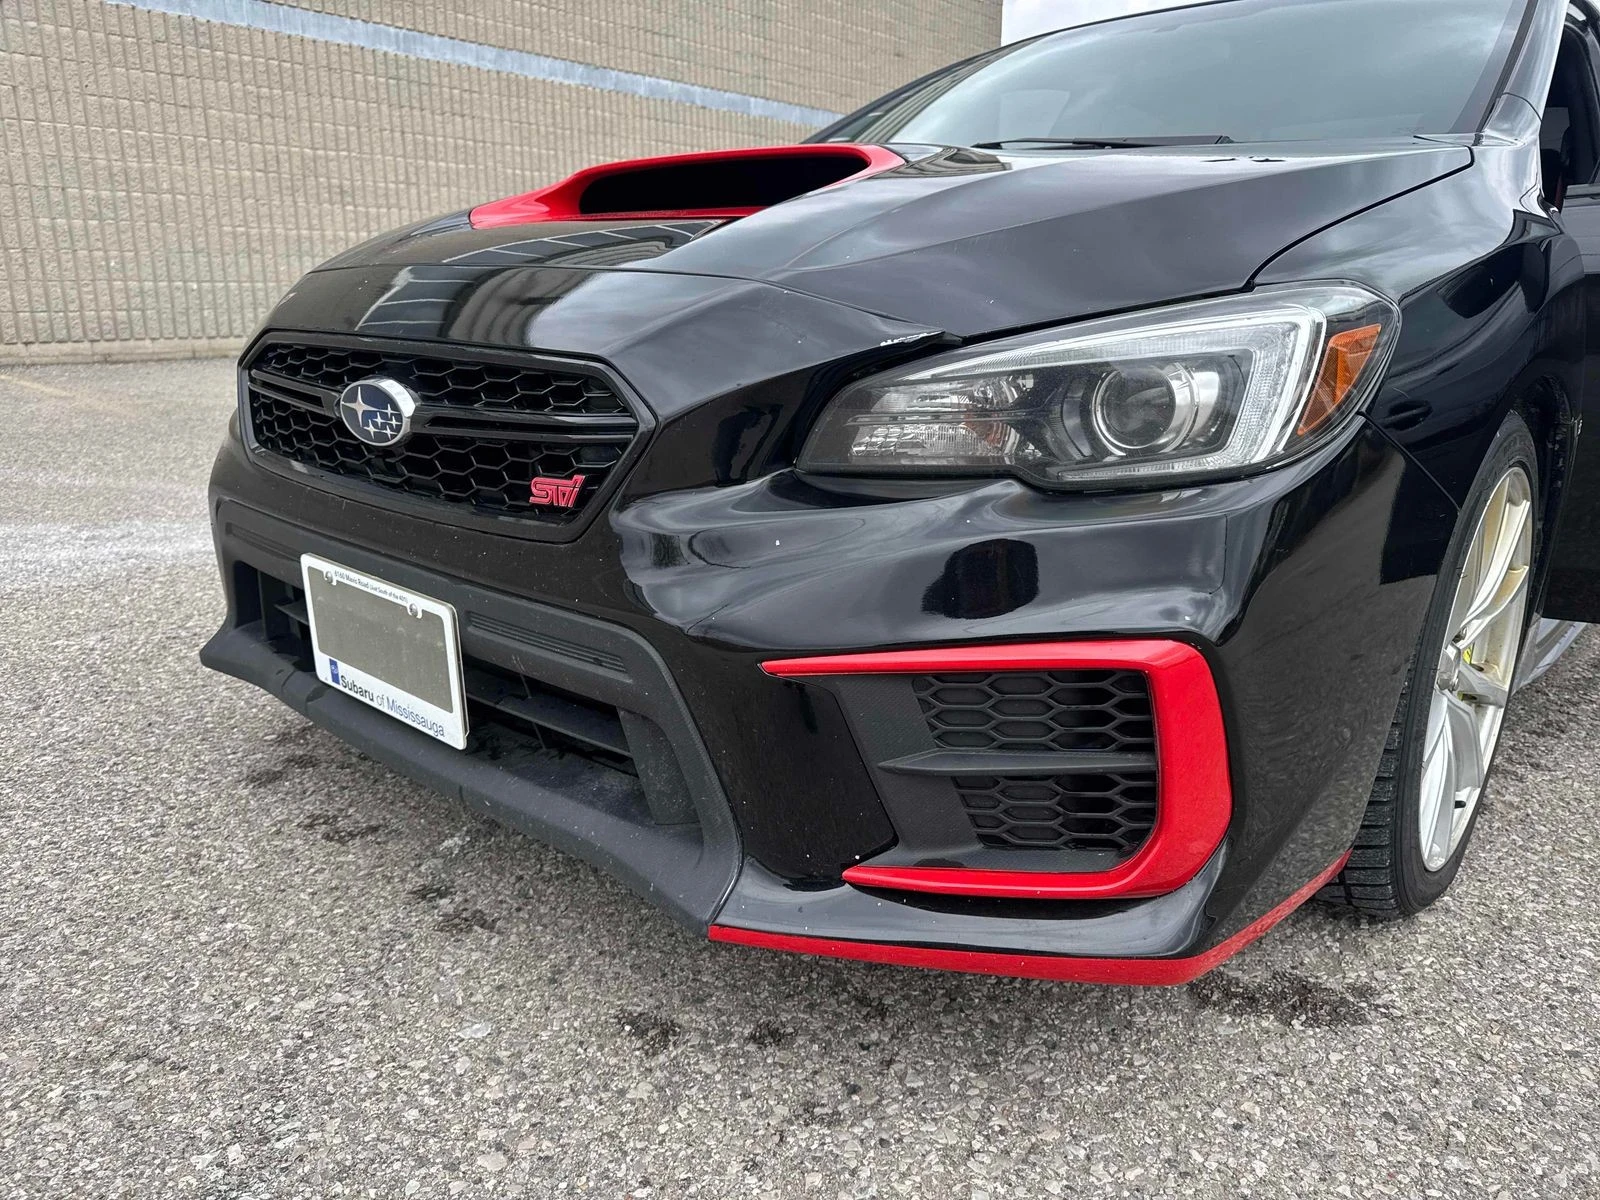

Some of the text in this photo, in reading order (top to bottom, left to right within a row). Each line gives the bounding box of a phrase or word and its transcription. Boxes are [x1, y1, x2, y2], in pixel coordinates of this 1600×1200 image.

[358, 578, 369, 589] Road
[340, 674, 445, 738] Subaru of Mississauga
